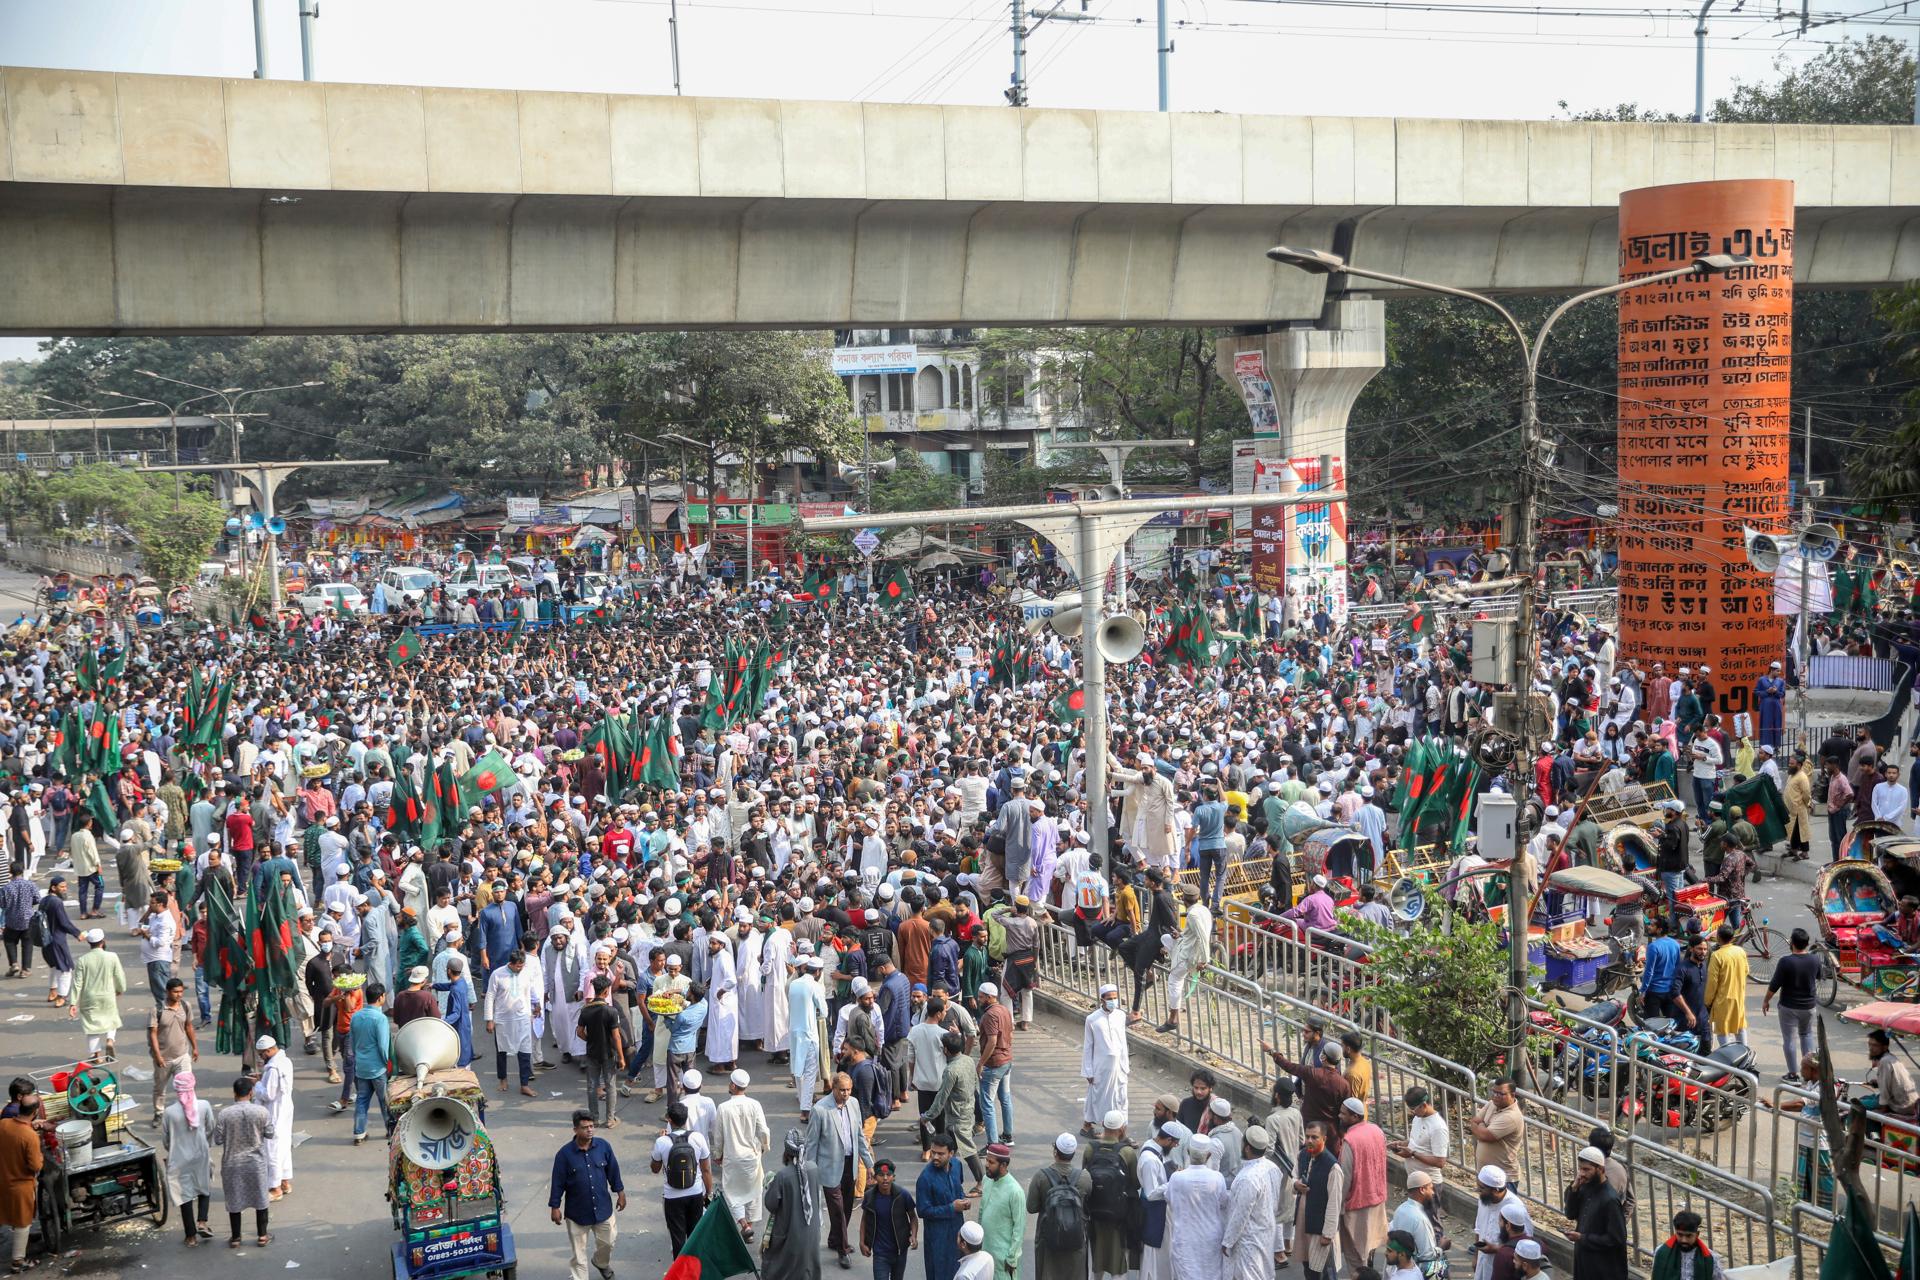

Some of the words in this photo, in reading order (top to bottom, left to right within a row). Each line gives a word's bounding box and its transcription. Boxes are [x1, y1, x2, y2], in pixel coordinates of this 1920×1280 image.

[1628, 231, 1711, 264] জুলাই
[1723, 229, 1778, 257] ৩৬
[1636, 290, 1710, 305] বাংলাদেশ
[1722, 284, 1743, 299] যদি
[1748, 284, 1768, 301] তুমি
[1642, 315, 1710, 332] জাস্টিস
[1722, 312, 1750, 328] উই
[1629, 339, 1666, 353] অথবা
[1673, 337, 1709, 355] মৃত্যু
[1723, 329, 1777, 352] জন্মভূমি
[1643, 356, 1709, 371] অধিকার
[1641, 375, 1709, 391] রাজাকার
[1723, 398, 1764, 409] তোমরা
[1649, 413, 1708, 430] ইতিহাস
[1629, 437, 1671, 450] রাখবো
[1674, 435, 1709, 449] মনে
[1722, 436, 1743, 448] সে
[1630, 455, 1672, 468] পোলার
[1676, 454, 1708, 467] লাশ
[1722, 455, 1741, 467] যে
[1678, 579, 1707, 593] কর
[1023, 605, 1054, 620] রাজ
[1720, 620, 1745, 631] কত
[1720, 686, 1762, 713] ৩
[419, 1119, 470, 1162] রাজ
